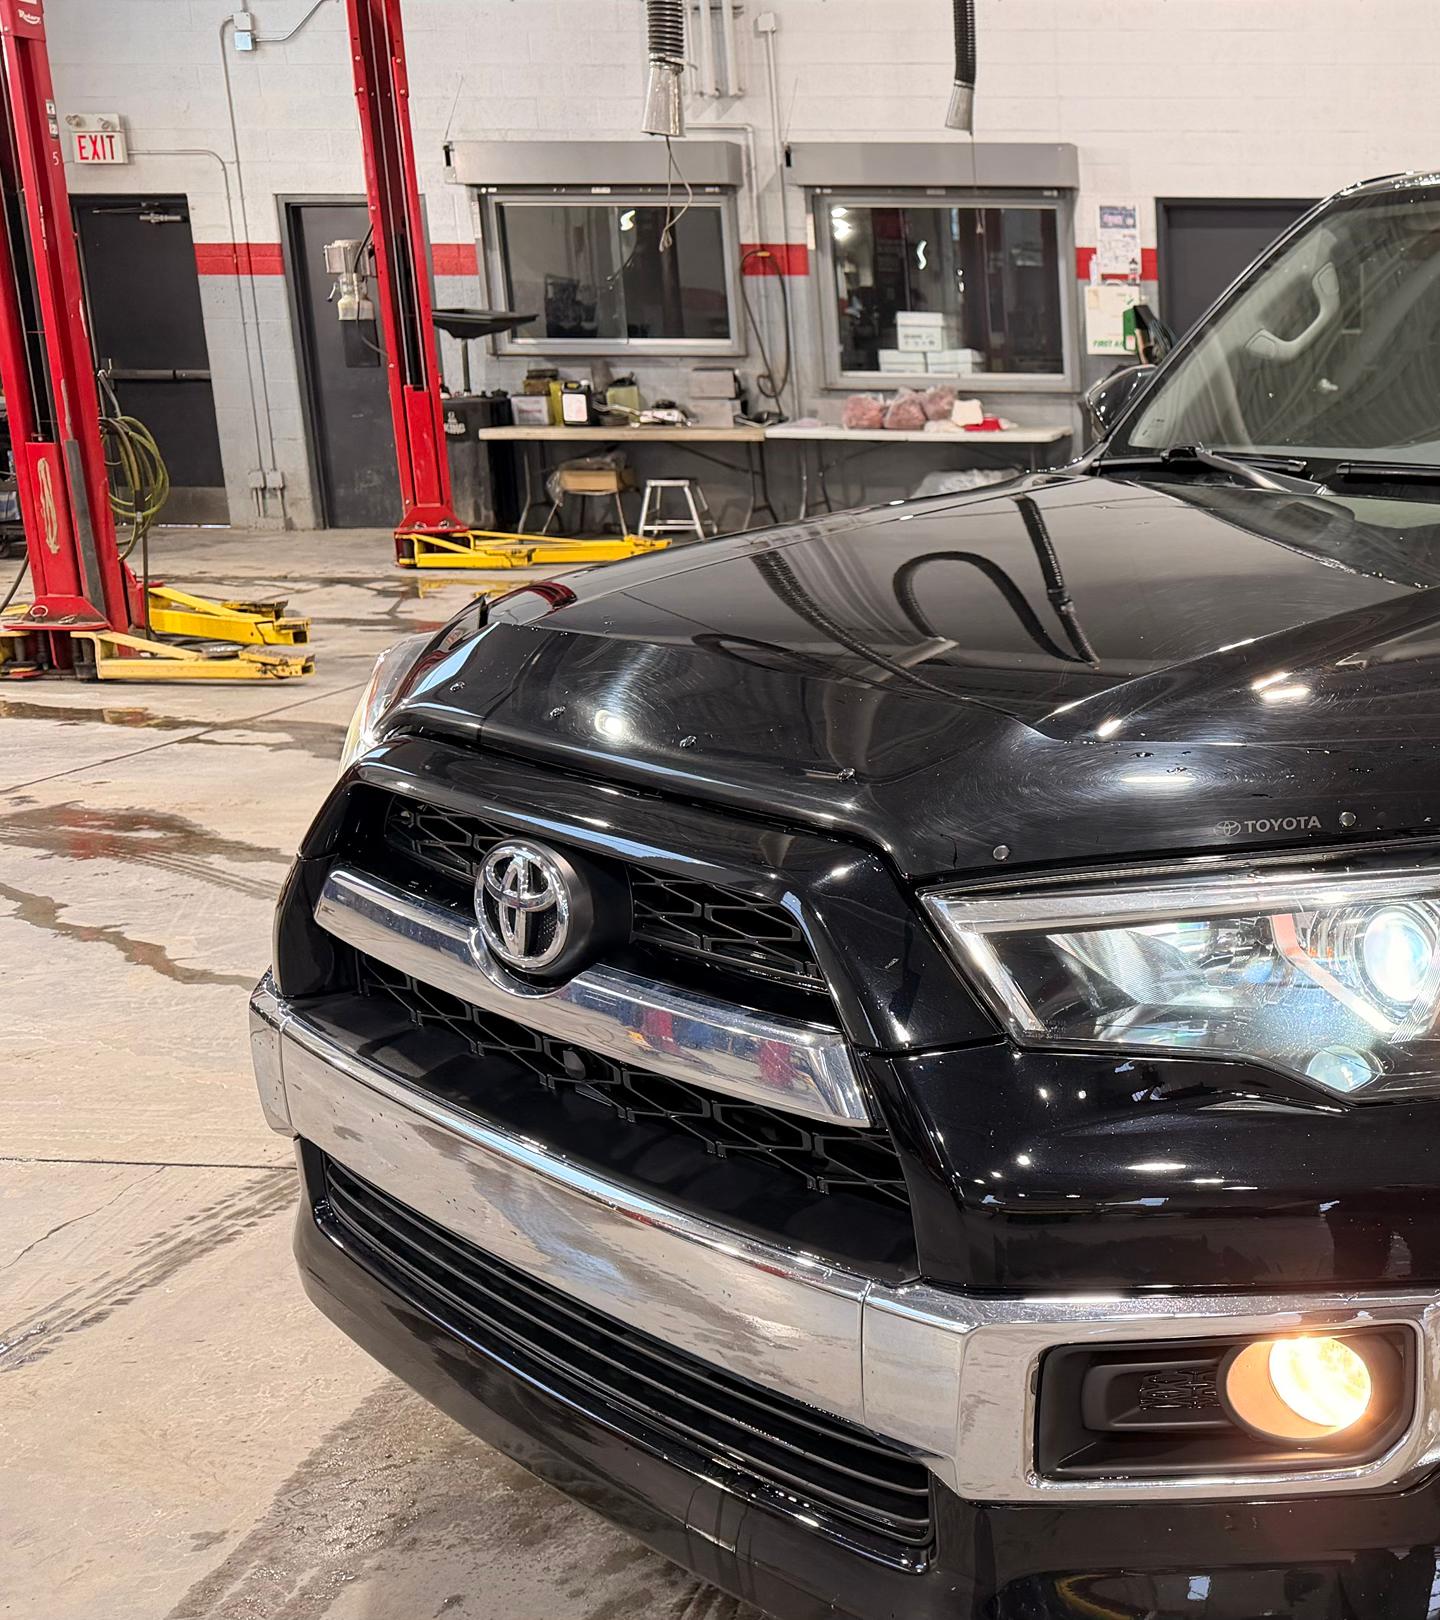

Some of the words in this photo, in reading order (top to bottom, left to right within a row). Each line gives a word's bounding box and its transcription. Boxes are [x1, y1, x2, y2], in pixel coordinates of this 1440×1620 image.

[77, 134, 115, 160] EXIT
[52, 151, 59, 165] 5
[1244, 816, 1322, 833] TOYOTA
